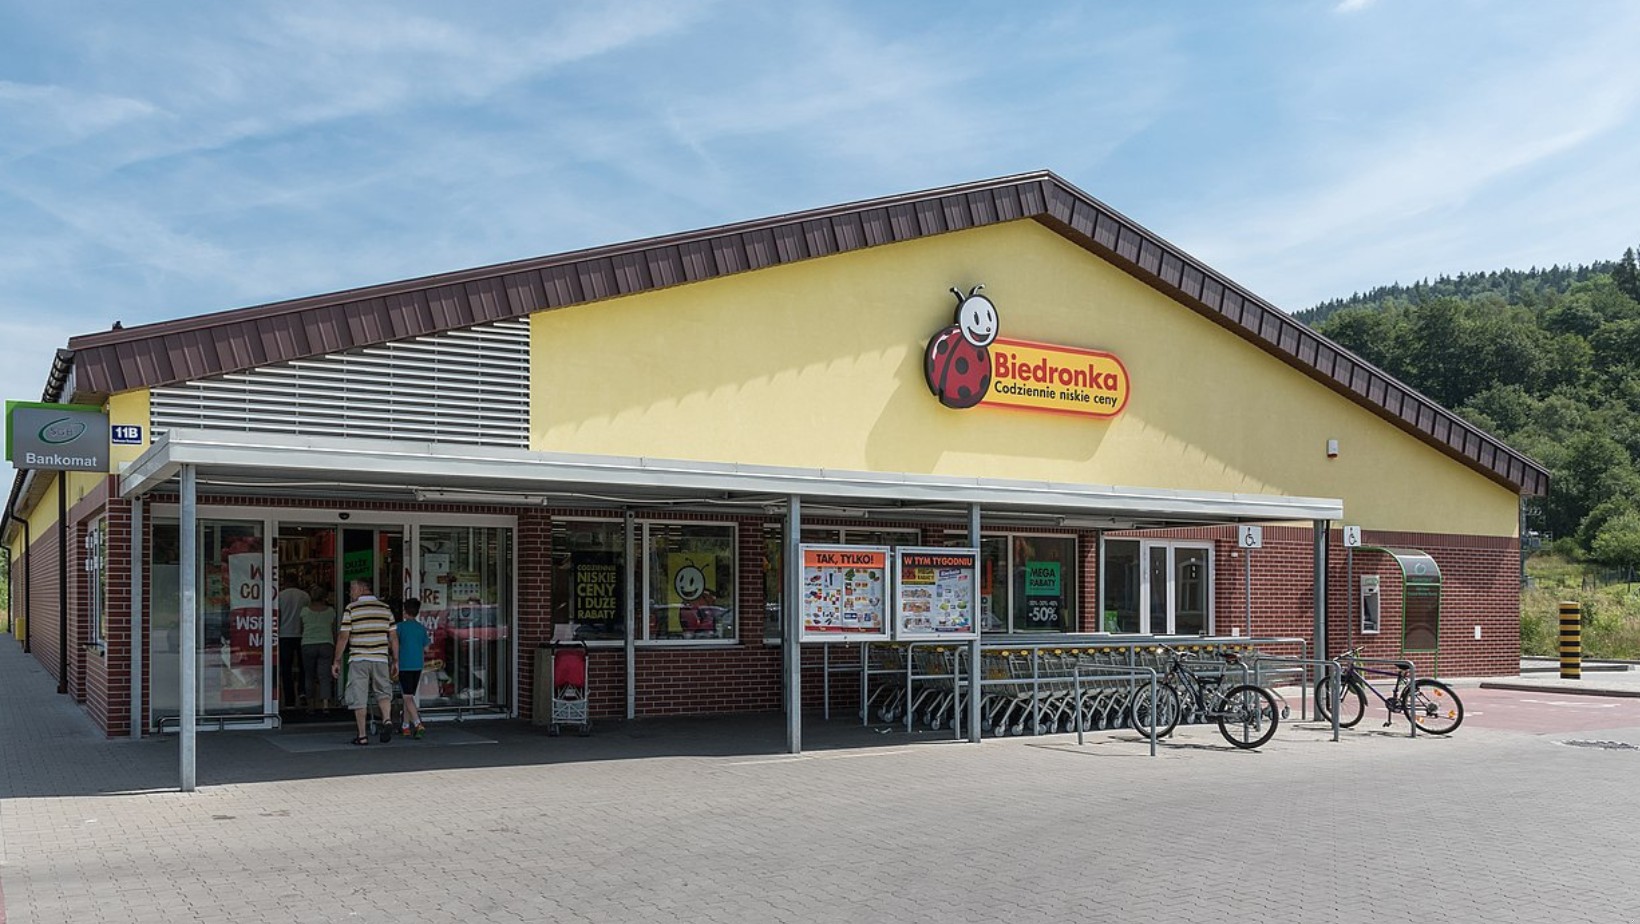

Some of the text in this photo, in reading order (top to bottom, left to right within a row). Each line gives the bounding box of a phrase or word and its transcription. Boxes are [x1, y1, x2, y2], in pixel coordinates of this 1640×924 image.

[994, 352, 1118, 391] Biedronka
[994, 381, 1118, 407] Codziennie niskie ceny
[115, 426, 138, 438] 11B
[26, 453, 97, 467] Bankomat
[816, 553, 874, 565] TAK, TYLKO!
[904, 556, 973, 566] W TYM TYGODNIU
[577, 572, 616, 583] NISKIE
[1031, 568, 1056, 578] MEGA
[577, 583, 615, 597] CENY
[578, 595, 616, 609] I DUŻE
[578, 610, 615, 620] RABATY
[1029, 607, 1058, 622] -50%
